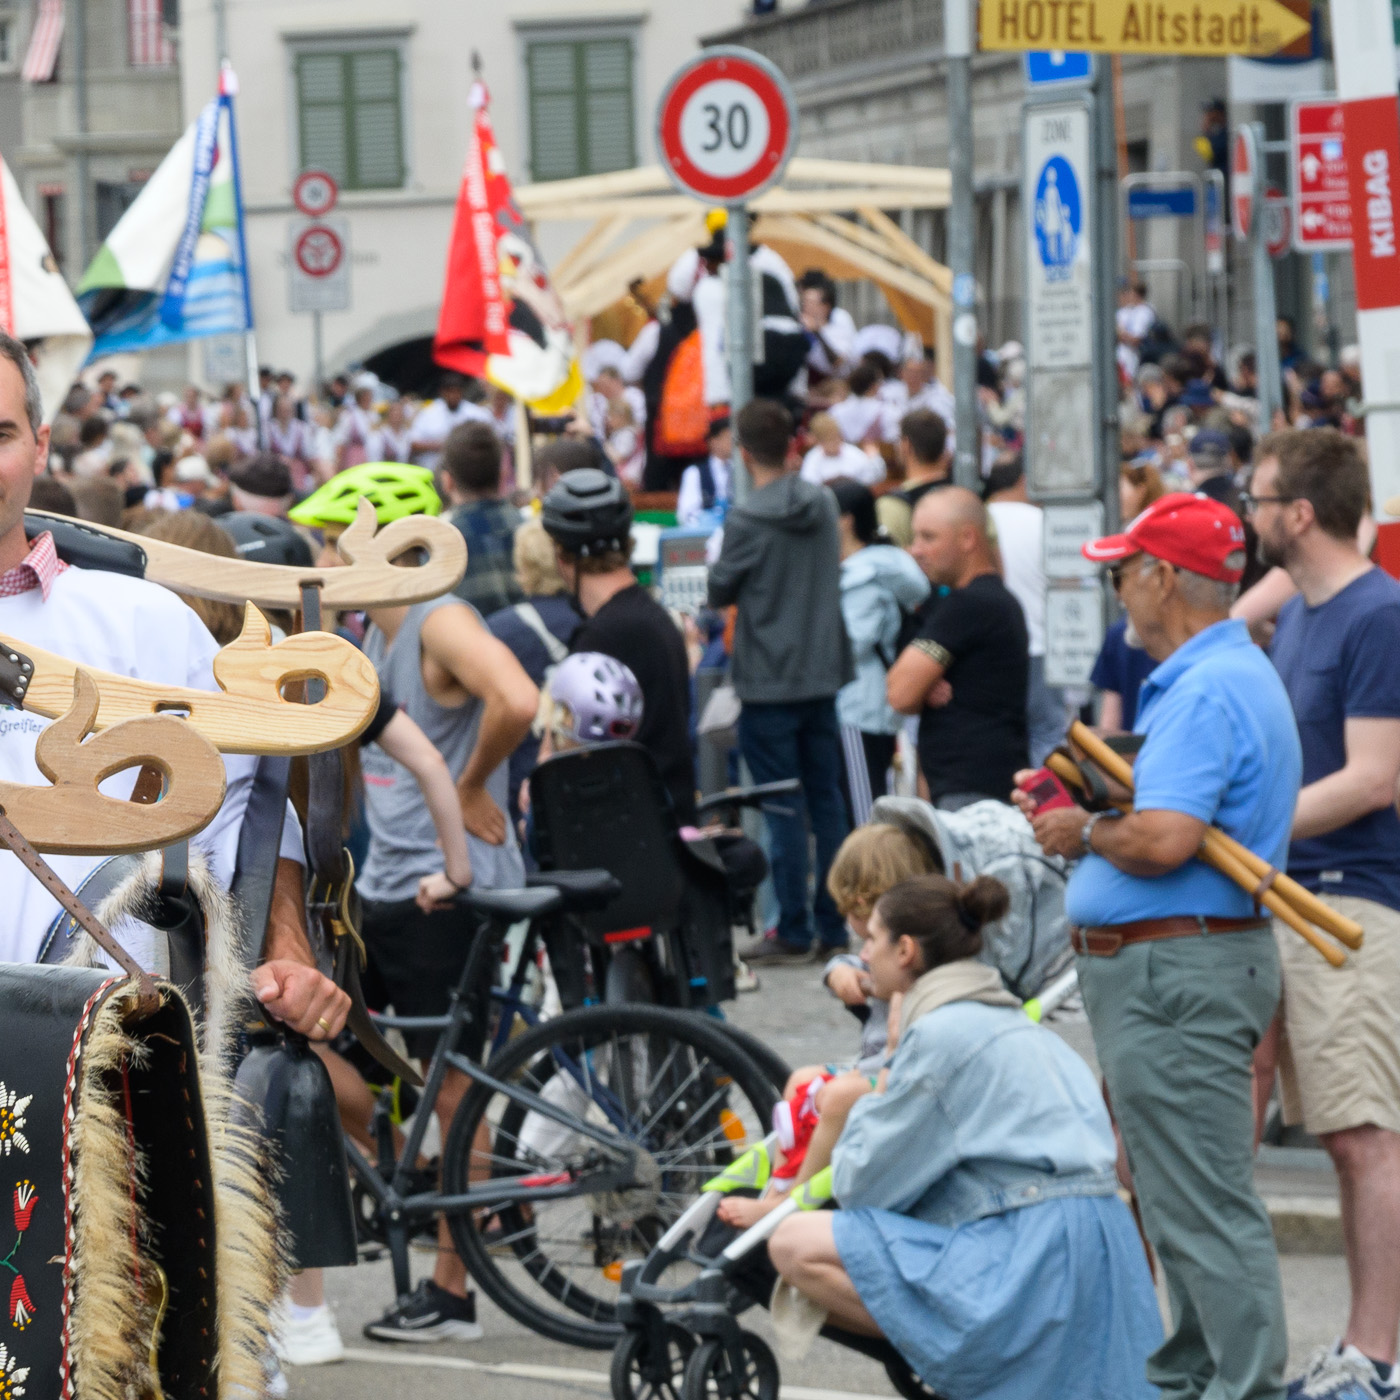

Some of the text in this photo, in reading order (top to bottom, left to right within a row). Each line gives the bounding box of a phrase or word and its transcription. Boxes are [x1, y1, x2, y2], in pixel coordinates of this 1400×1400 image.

[998, 0, 1264, 47] HOTEL Altstadt
[702, 103, 751, 152] 30
[1363, 149, 1397, 259] KIBAG
